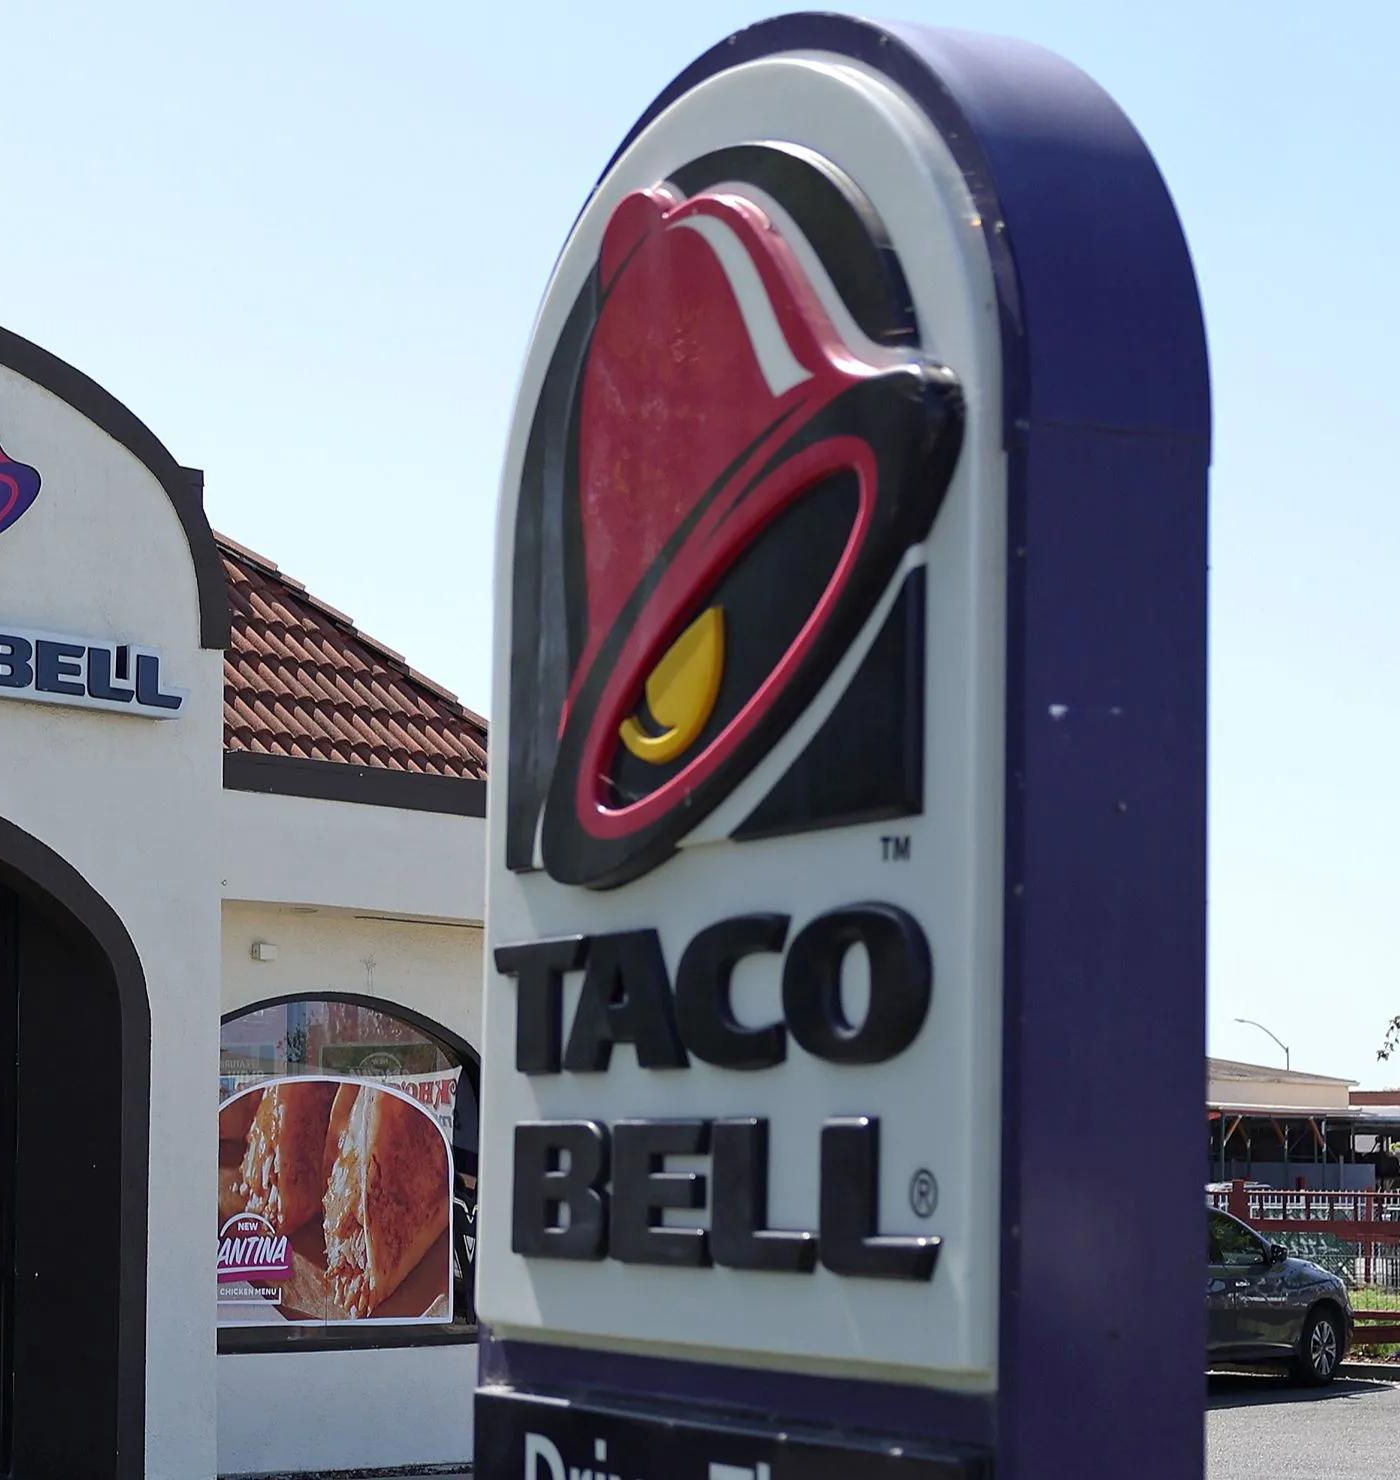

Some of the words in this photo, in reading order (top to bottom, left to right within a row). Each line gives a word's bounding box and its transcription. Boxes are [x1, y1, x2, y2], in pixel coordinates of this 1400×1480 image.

[880, 836, 912, 862] TM
[494, 900, 934, 1074] TACO
[512, 1116, 942, 1281] BELL
[238, 1222, 258, 1231] NEW
[216, 1235, 288, 1265] ANTINA
[220, 1287, 253, 1296] CHICKEN
[254, 1287, 277, 1296] MENU
